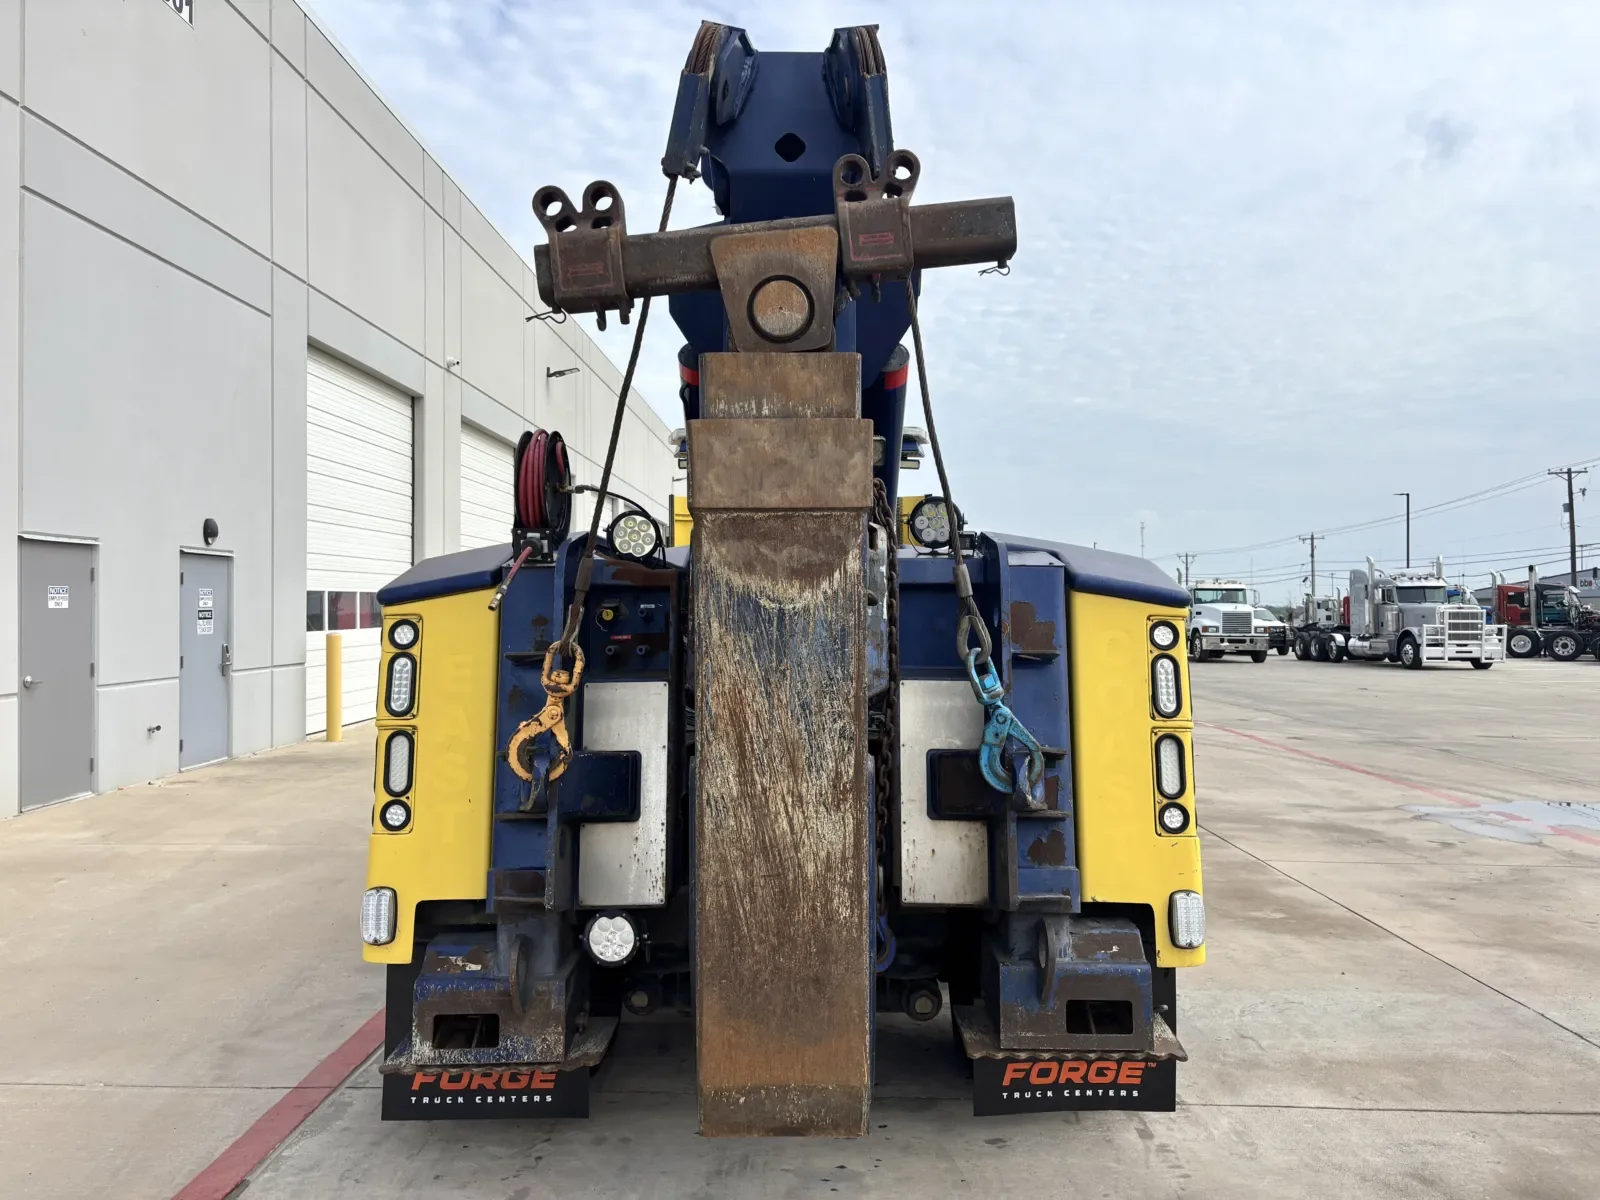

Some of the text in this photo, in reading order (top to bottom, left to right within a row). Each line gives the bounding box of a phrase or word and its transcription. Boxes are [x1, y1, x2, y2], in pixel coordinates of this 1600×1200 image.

[411, 1068, 558, 1091] FORGE
[1002, 1061, 1146, 1086] FORGE
[410, 1095, 553, 1104] TRUCK CENTERS
[1002, 1089, 1140, 1099] TRUCK CENTERS
